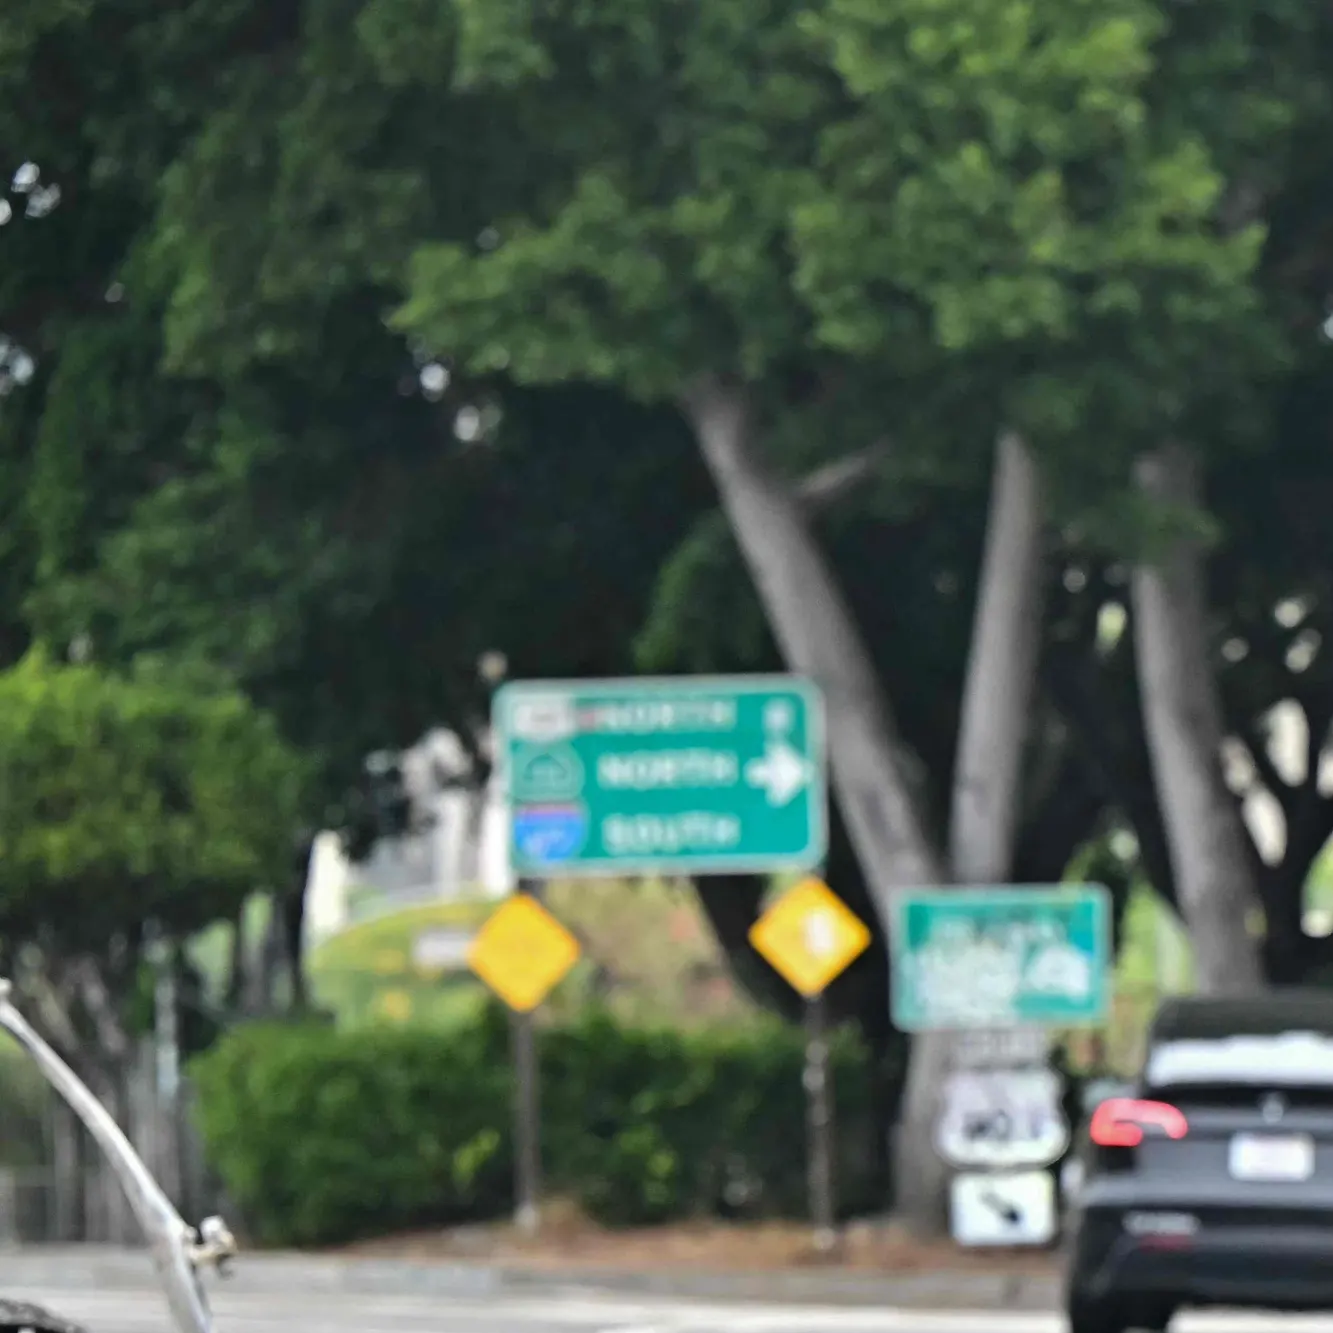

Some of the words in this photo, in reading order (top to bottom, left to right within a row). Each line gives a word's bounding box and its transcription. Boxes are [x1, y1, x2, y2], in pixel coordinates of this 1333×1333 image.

[598, 702, 736, 732] NORTH
[599, 751, 737, 788] NORTH
[603, 815, 739, 853] SOUTH
